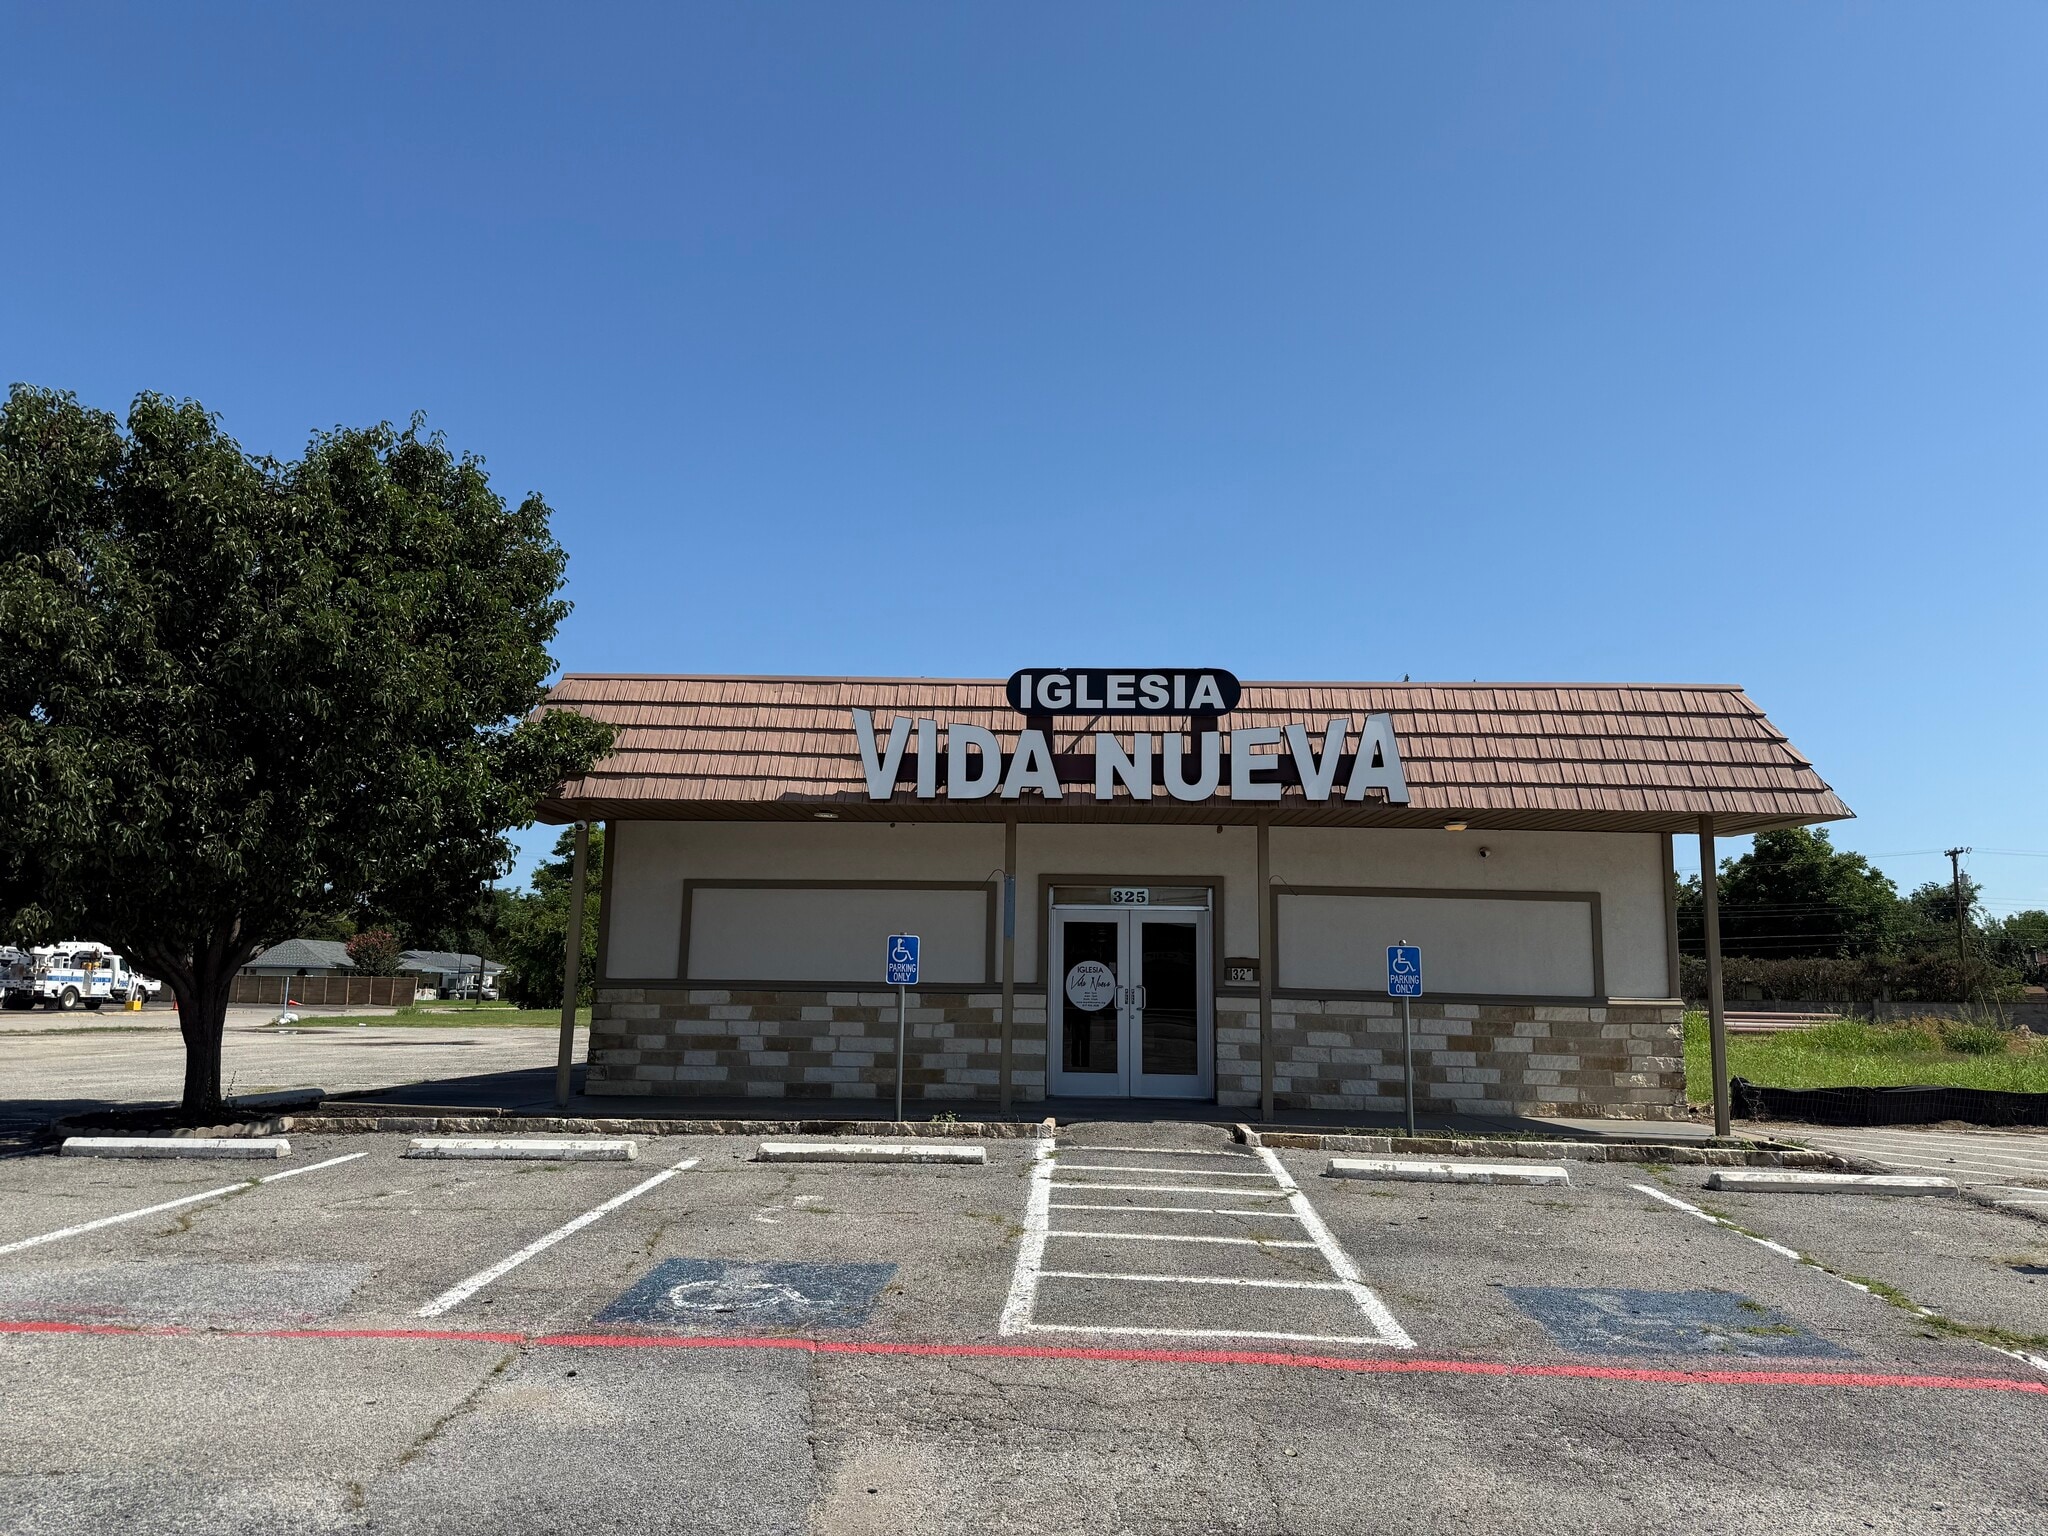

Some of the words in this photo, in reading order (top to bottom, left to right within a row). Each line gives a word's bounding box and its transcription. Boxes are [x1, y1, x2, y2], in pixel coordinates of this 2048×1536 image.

[1019, 674, 1226, 710] IGLESIA
[851, 707, 1064, 800] VIDA
[1094, 712, 1411, 804] NUEVA
[1113, 890, 1146, 903] 325
[889, 964, 916, 972] PARKING
[894, 972, 911, 981] ONLY
[1233, 968, 1252, 980] 32
[1390, 975, 1419, 984] PARKING
[1396, 984, 1414, 993] ONLY
